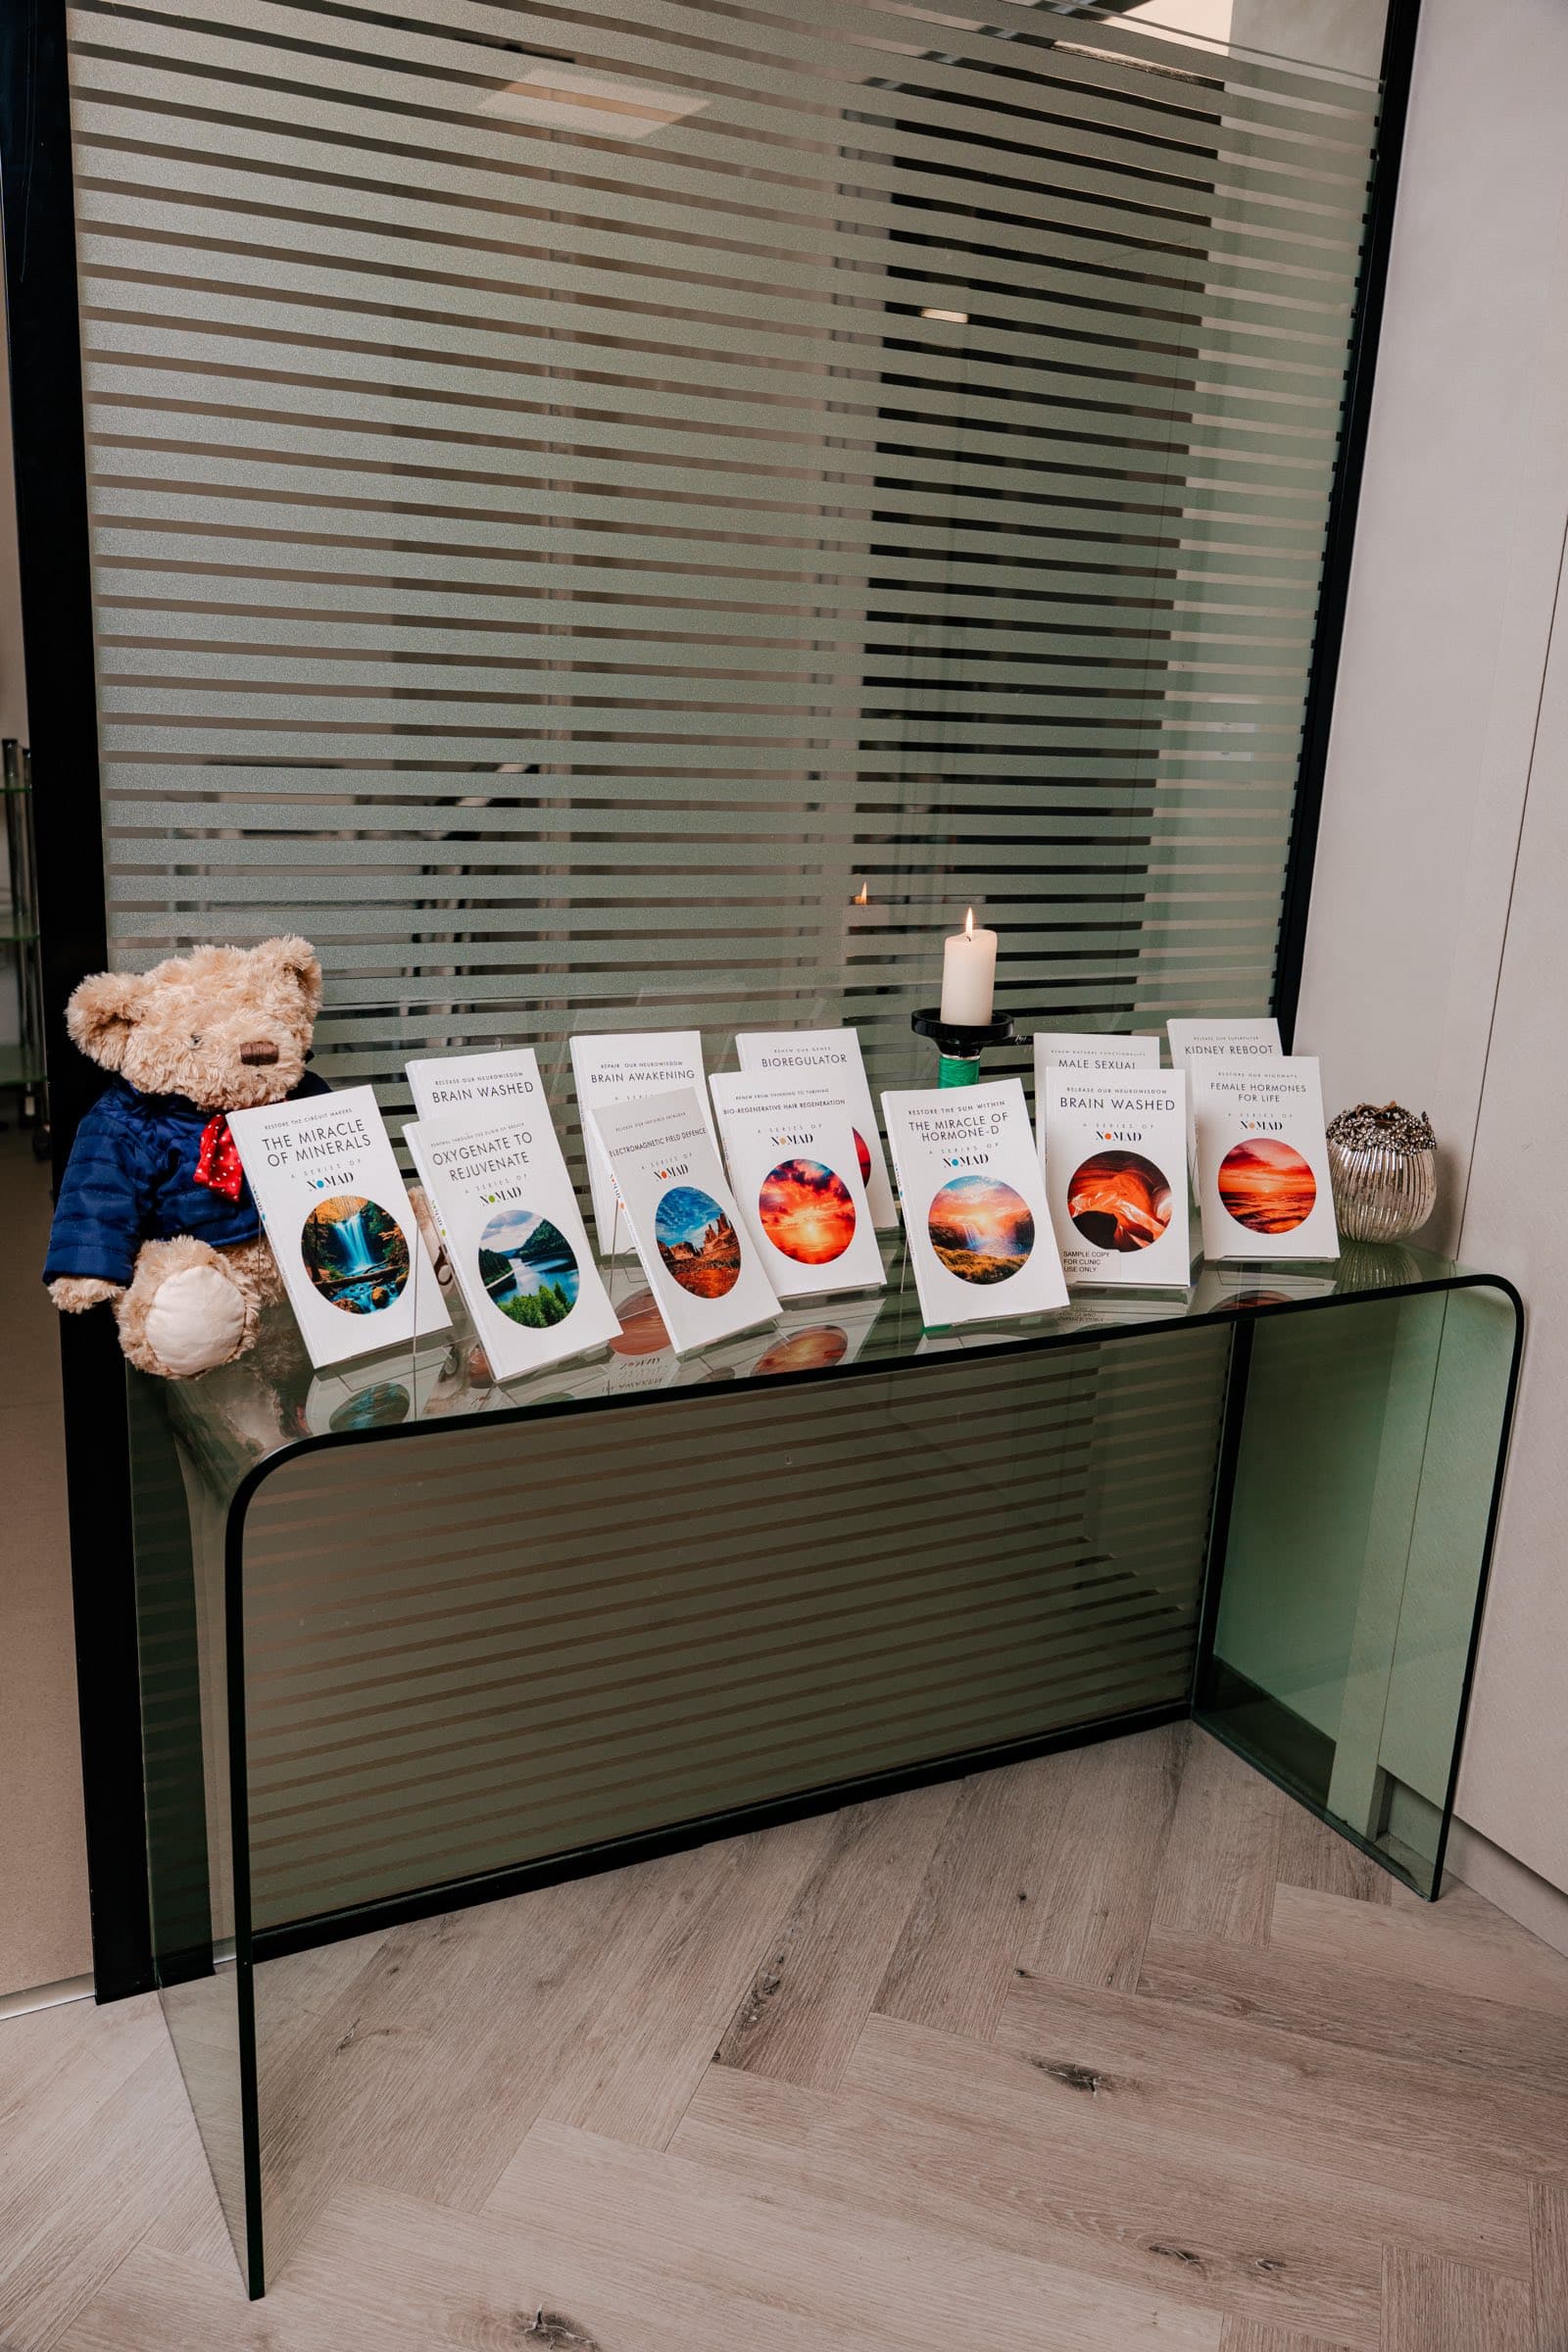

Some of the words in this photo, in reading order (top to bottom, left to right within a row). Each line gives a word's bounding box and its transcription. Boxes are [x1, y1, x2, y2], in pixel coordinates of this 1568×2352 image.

[1185, 1046, 1225, 1054] KIDNEY
[1230, 1045, 1273, 1054] REBOOT
[761, 1054, 847, 1068] BIOREGULATOR
[1059, 1060, 1089, 1069] MALE
[591, 1073, 624, 1083] BRAIN
[629, 1070, 695, 1082] AWAKENING
[432, 1088, 472, 1103] BRAIN
[477, 1081, 533, 1097] WASHED
[1211, 1083, 1246, 1091] FEMALE
[1250, 1084, 1306, 1093] HORMONES
[977, 1101, 1005, 1109] WITHIN
[1060, 1097, 1104, 1108] BRAIN
[1111, 1099, 1175, 1111] WASHED
[1239, 1094, 1258, 1102] FOR
[724, 1104, 781, 1115] BIO-REGENERATIVE
[800, 1099, 845, 1109] REGENERATION
[909, 1121, 930, 1132] THE
[935, 1116, 985, 1130] MIRACLE
[991, 1112, 1008, 1123] OF
[1240, 1121, 1283, 1130] NOMAD
[261, 1135, 292, 1151] THE
[299, 1119, 365, 1144] MIRACLE
[771, 1133, 813, 1147] NOMAD
[922, 1125, 999, 1142] HORMONE-D
[1096, 1131, 1142, 1142] NOMAD
[432, 1137, 510, 1166] OXYGENATE
[513, 1131, 532, 1145] TO
[609, 1138, 664, 1157] ELECTROMAGNETIC
[665, 1134, 681, 1143] FIELD
[682, 1127, 706, 1139] DEFENCE
[268, 1152, 289, 1167] OF
[296, 1134, 372, 1162] MINERALS
[449, 1151, 529, 1182] REJUVENATE
[943, 1153, 989, 1168] NOMAD
[653, 1163, 689, 1181] NOMAD
[307, 1172, 354, 1191] NOMAD
[480, 1187, 522, 1207] NOMAD
